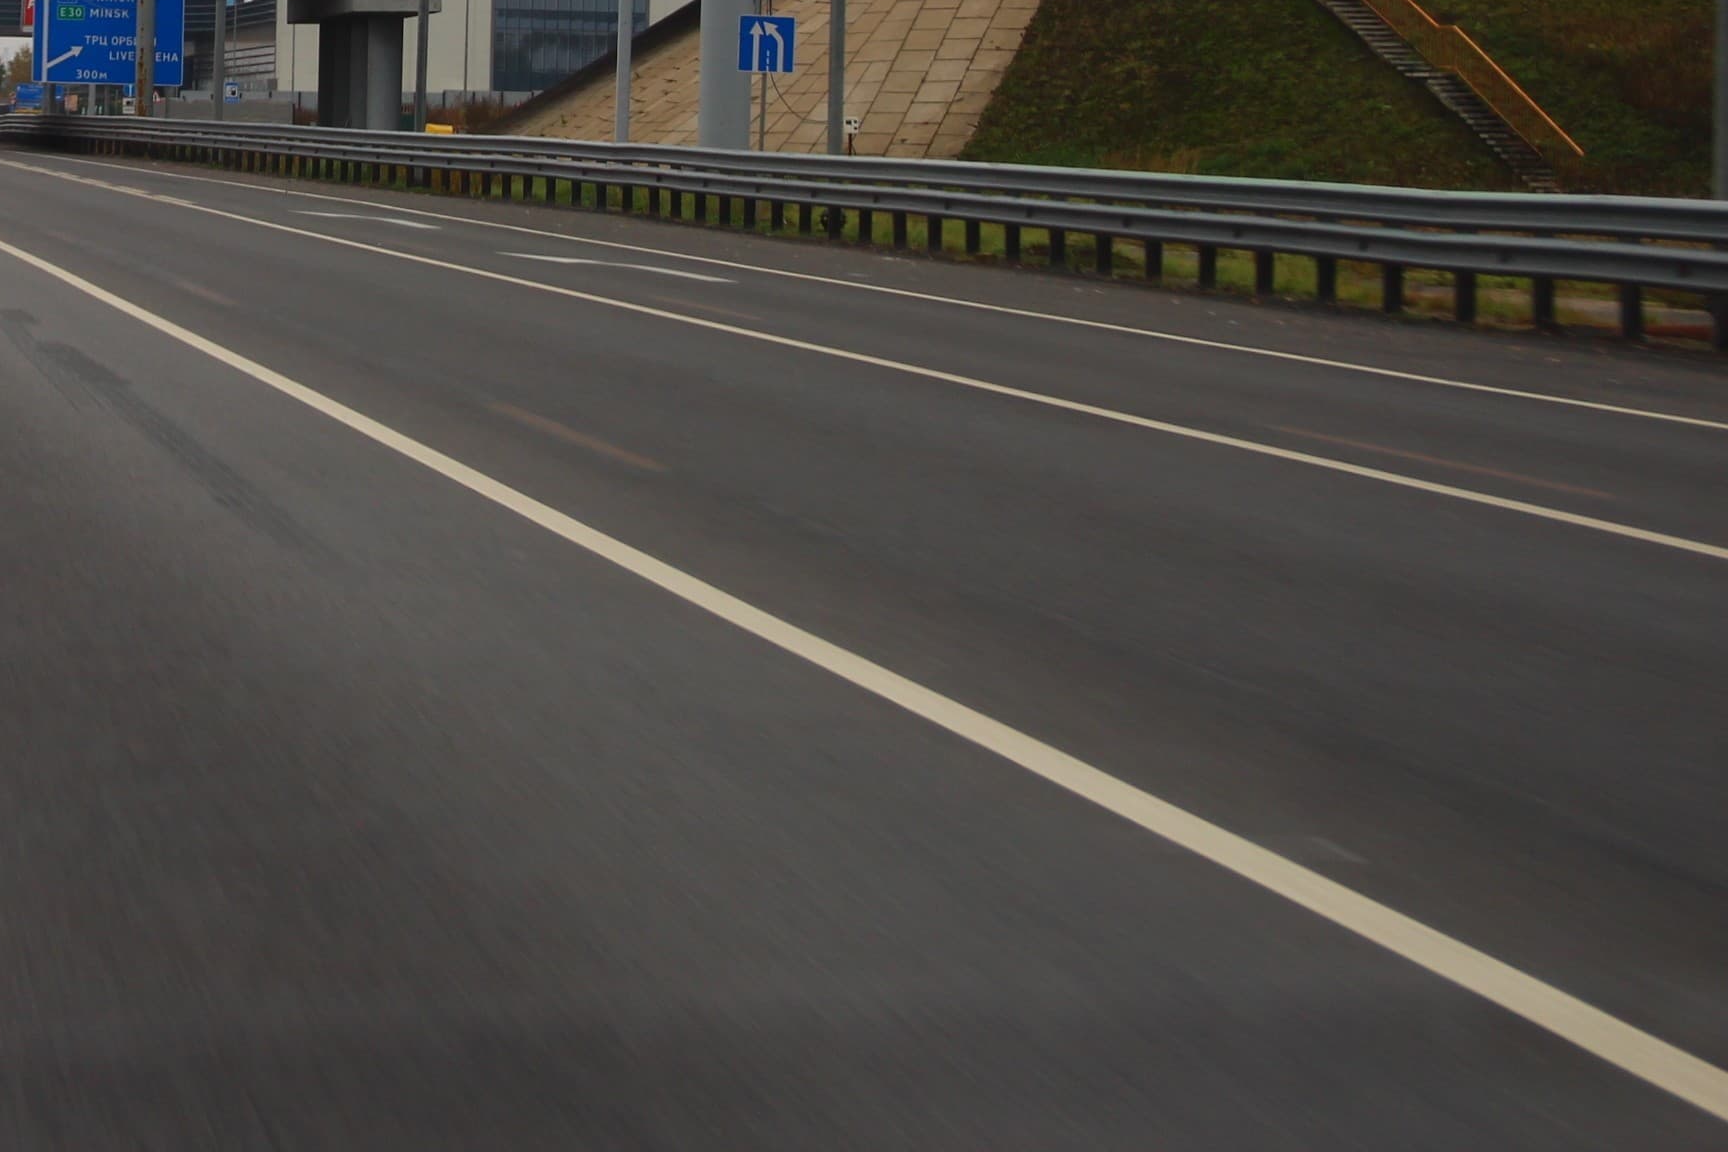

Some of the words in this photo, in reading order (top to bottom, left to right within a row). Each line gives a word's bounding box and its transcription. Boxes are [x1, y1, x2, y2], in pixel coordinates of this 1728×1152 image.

[89, 8, 129, 19] MINSK
[84, 35, 108, 46] ТРЦ
[109, 51, 137, 61] LIVE
